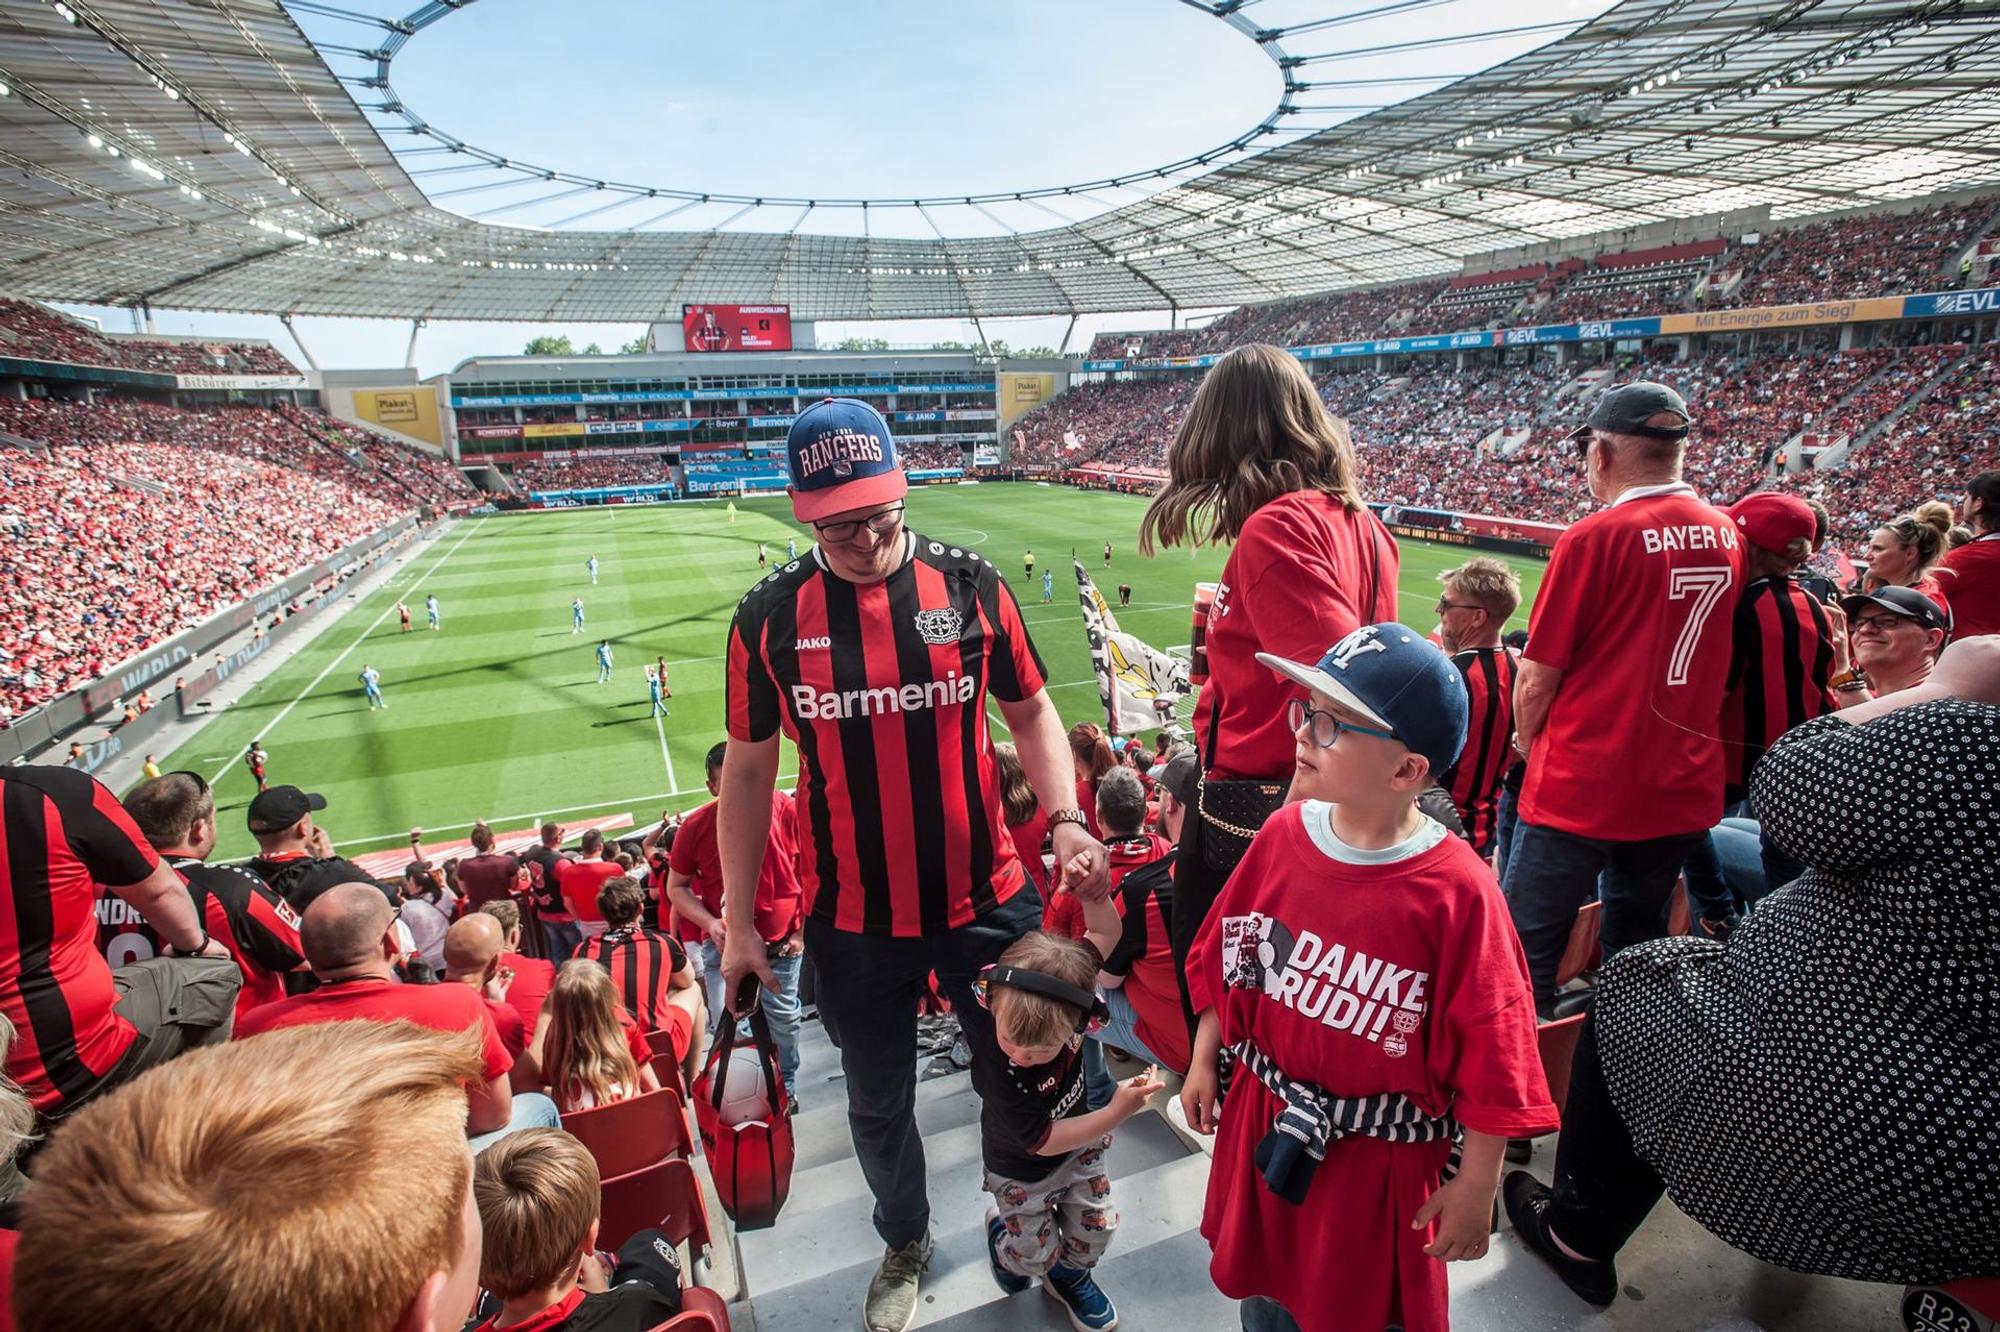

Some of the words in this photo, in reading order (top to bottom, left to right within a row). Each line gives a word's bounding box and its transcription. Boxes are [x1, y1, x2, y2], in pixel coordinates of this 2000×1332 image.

[1955, 291, 2000, 312] EVL
[1696, 315, 1715, 327] Mit
[1720, 310, 1772, 327] Energie
[1777, 309, 1810, 322] zum
[1814, 303, 1856, 321] Sieg!
[1517, 330, 1538, 343] EVL
[1590, 324, 1615, 338] EVL
[1383, 341, 1400, 351] JAKO
[1461, 335, 1482, 345] JAKO
[183, 376, 237, 388] Bitburger
[716, 419, 738, 429] Bayer
[916, 412, 936, 421] JAKO
[799, 433, 883, 477] RANGERS
[1641, 525, 1718, 554] BAYER
[1719, 526, 1739, 550] 04
[1667, 565, 1733, 686] 7
[794, 635, 832, 651] JAKO
[791, 670, 976, 721] Barmenia
[95, 898, 149, 926] NDR
